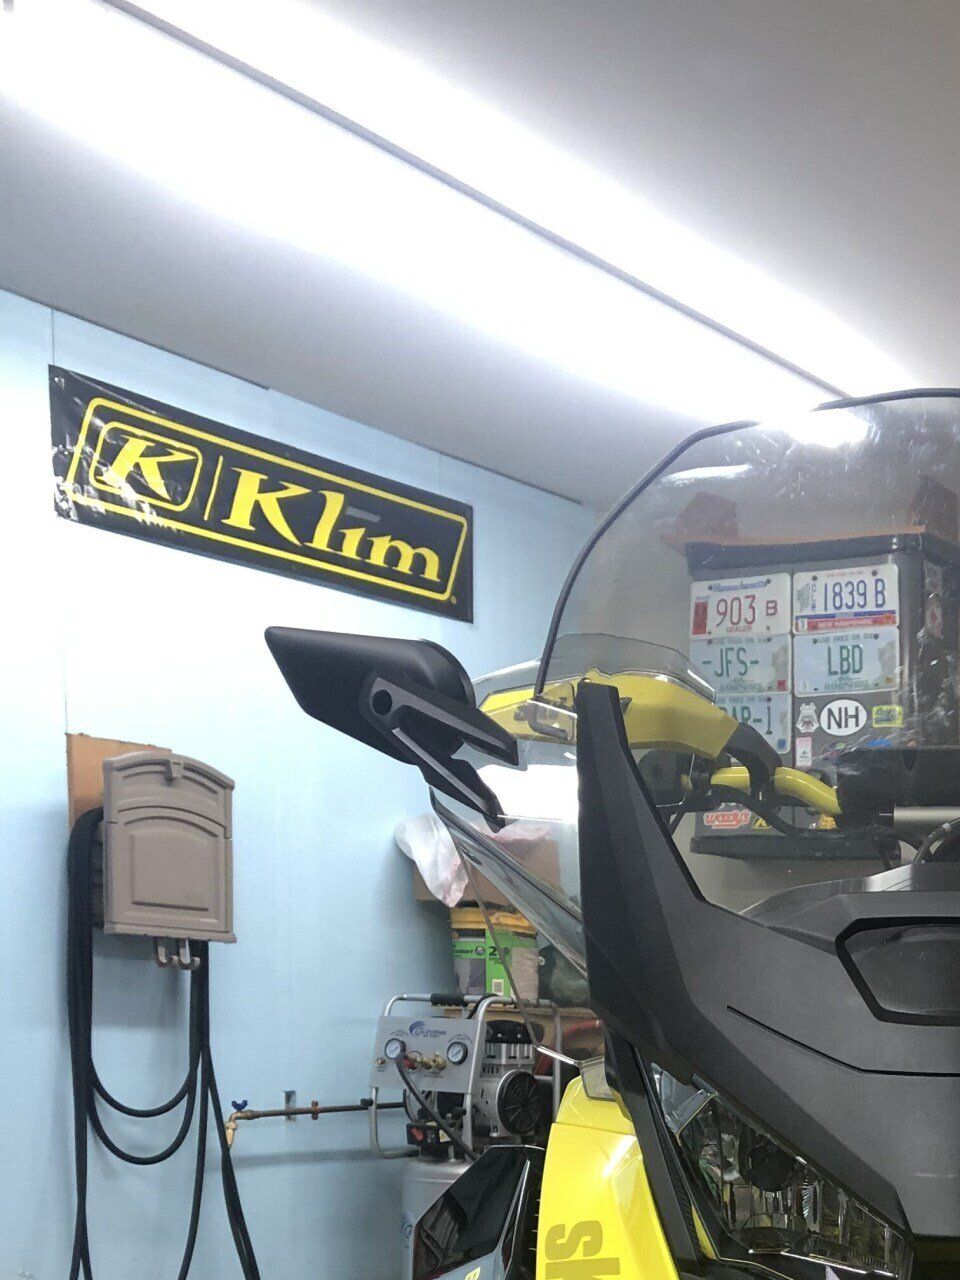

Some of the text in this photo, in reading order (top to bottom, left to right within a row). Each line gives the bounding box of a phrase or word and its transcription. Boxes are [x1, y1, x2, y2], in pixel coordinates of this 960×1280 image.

[220, 466, 442, 583] Klim
[716, 594, 778, 627] 903 B
[824, 578, 885, 612] 1839 B
[828, 644, 863, 675] LBD
[827, 705, 860, 730] NH
